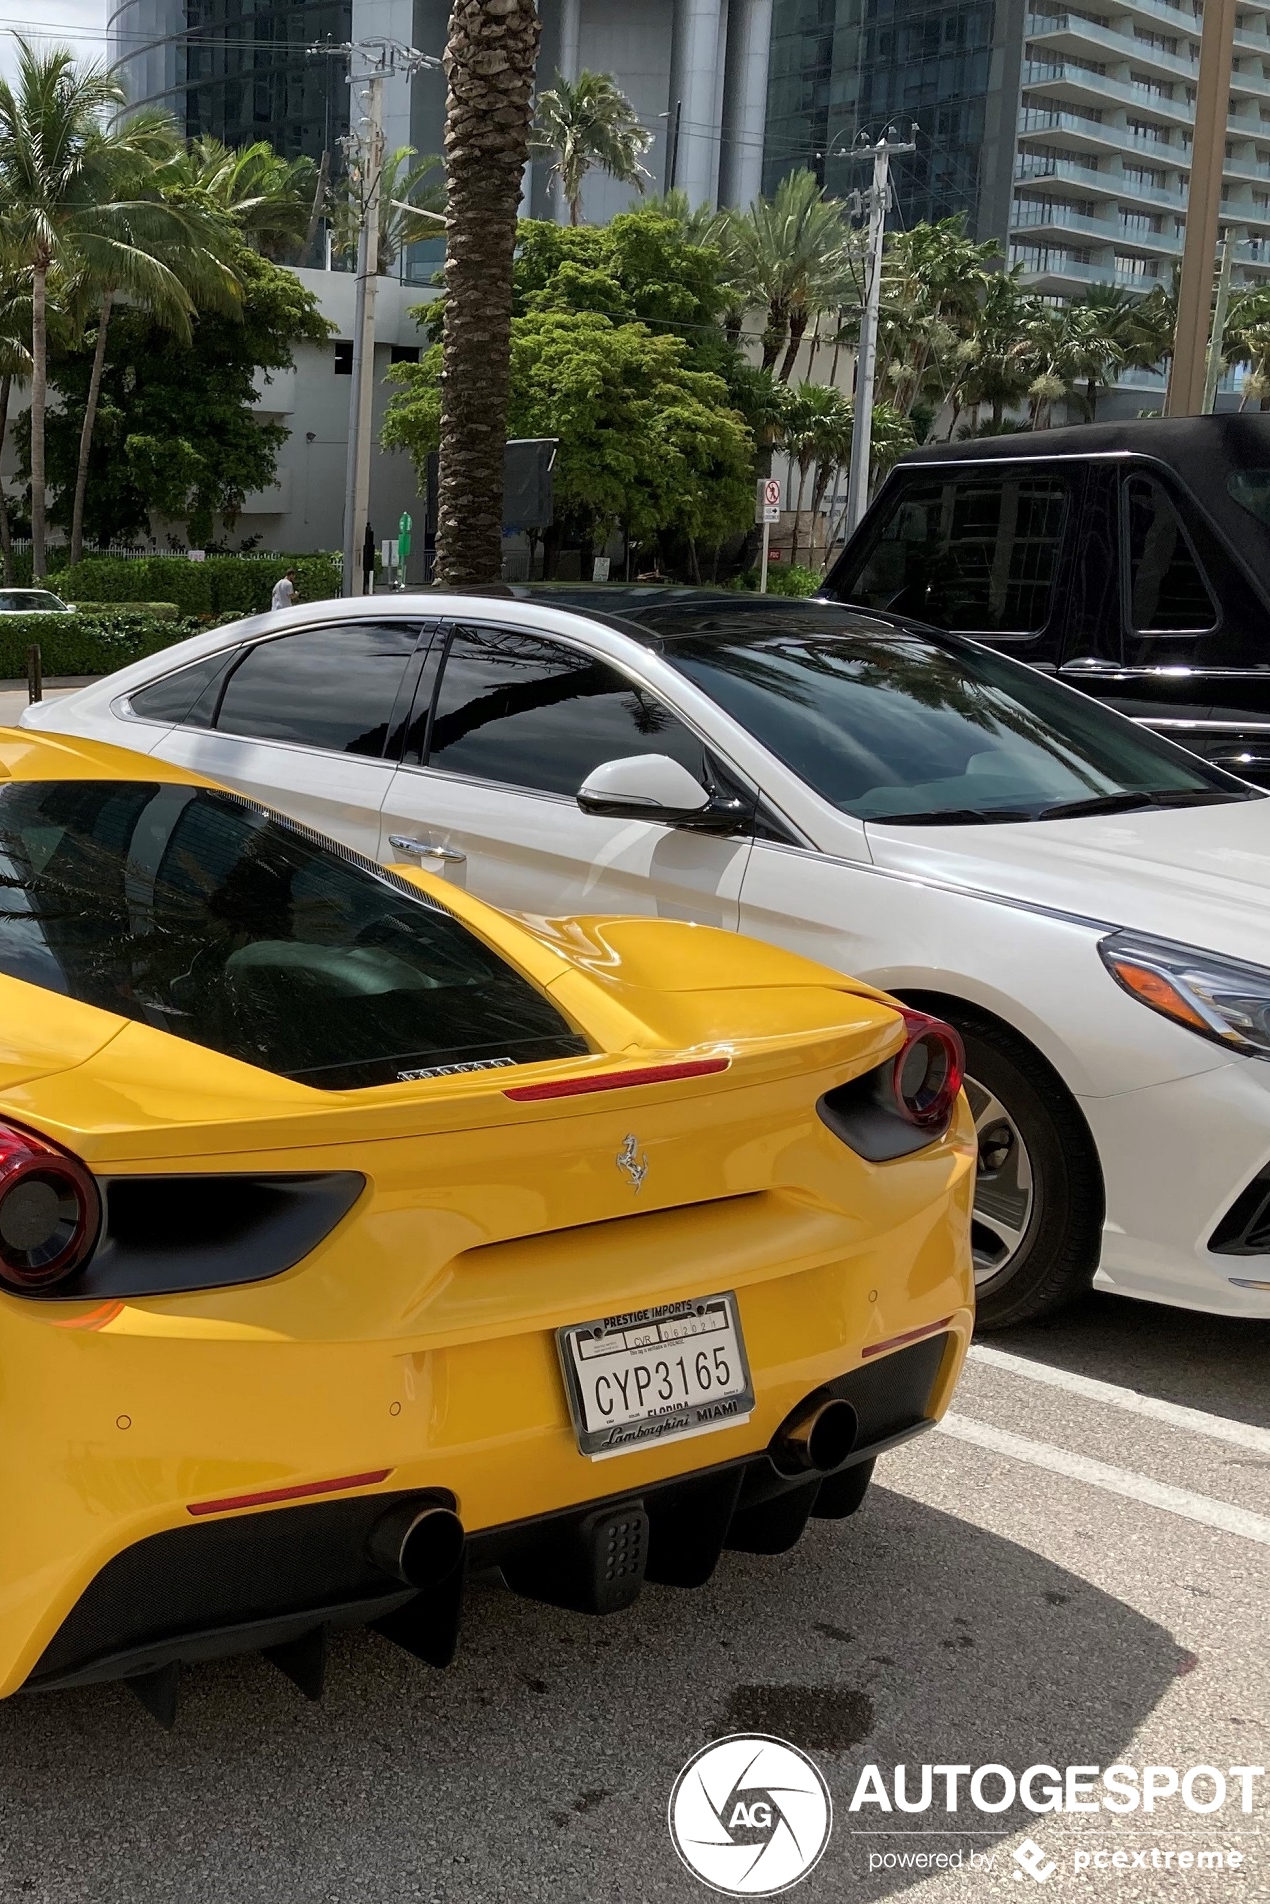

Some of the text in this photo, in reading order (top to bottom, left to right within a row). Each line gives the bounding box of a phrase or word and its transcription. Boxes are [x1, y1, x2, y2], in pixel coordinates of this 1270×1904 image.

[604, 1300, 692, 1329] PRESTIGE IMPORTS
[634, 1335, 652, 1347] CVR
[595, 1346, 730, 1416] CYP3165
[602, 1401, 738, 1446] Lamborghini MIAMI
